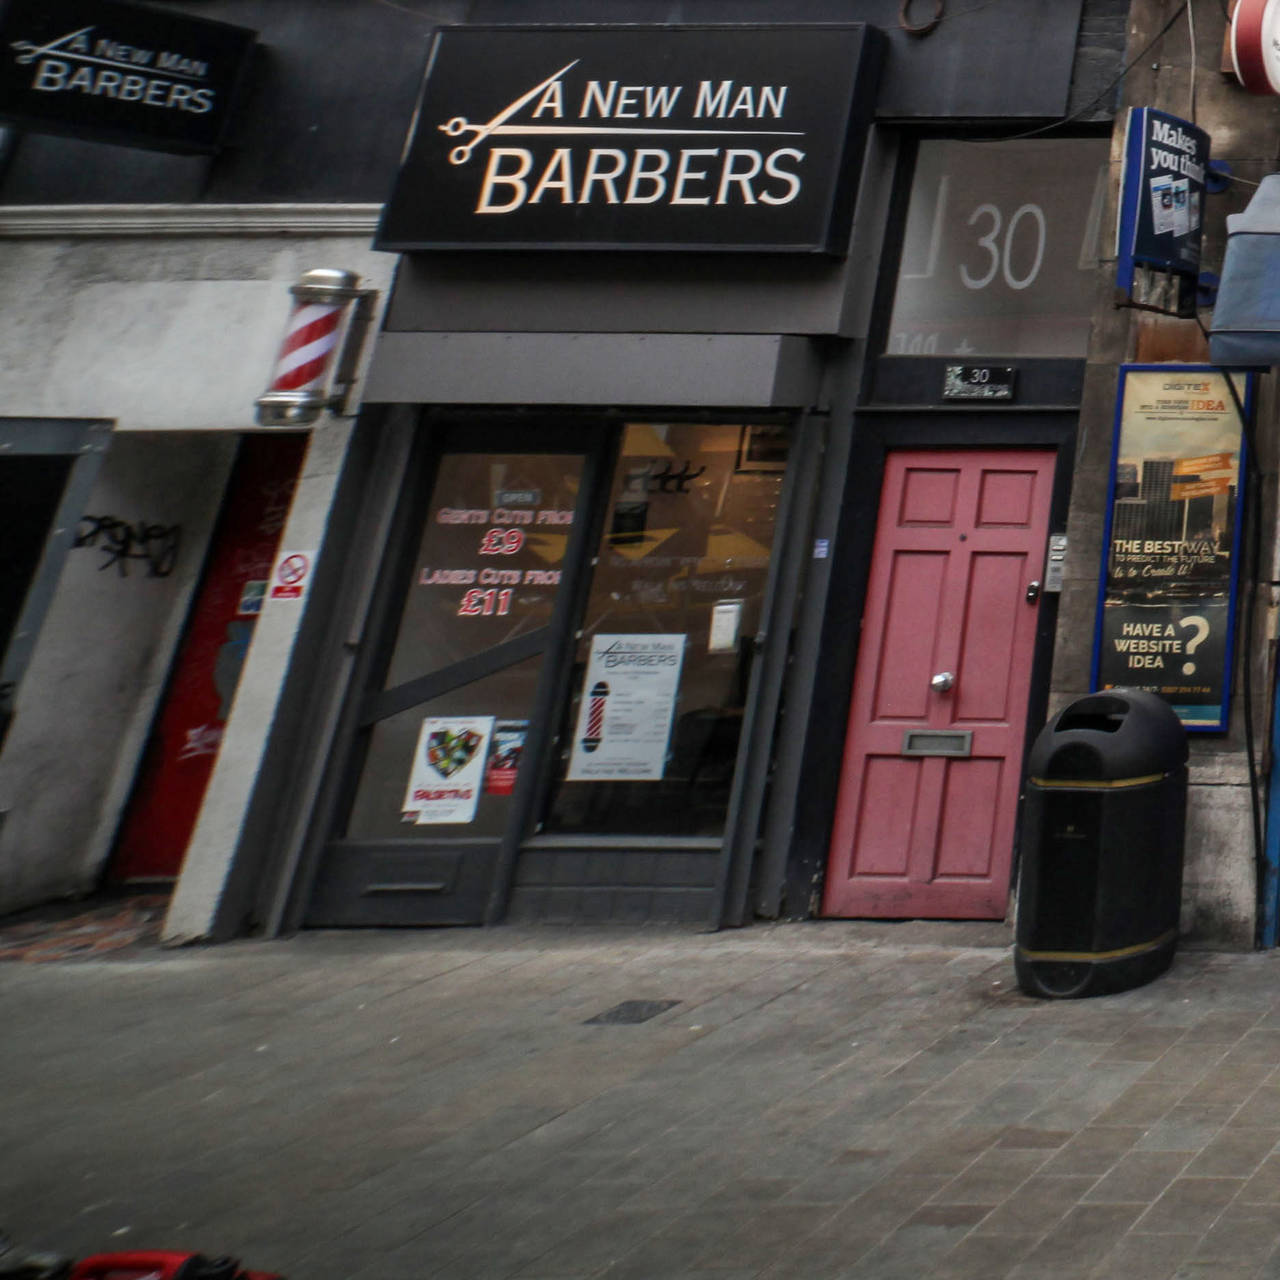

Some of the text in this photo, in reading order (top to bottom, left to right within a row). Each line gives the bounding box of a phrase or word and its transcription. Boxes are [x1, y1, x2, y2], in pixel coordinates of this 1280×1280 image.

[68, 35, 208, 75] A NEW MAN
[32, 60, 216, 113] BARBERS
[532, 81, 787, 118] A NEW MAN
[1152, 120, 1197, 154] Makes
[1151, 147, 1178, 171] you
[474, 148, 805, 214] BARBERS
[960, 203, 1046, 289] 30
[971, 369, 990, 383] 30
[1191, 400, 1225, 411] IDEA
[492, 508, 534, 524] CUTS
[478, 528, 525, 555] £9
[1114, 540, 1220, 554] THE BEST WAY
[1127, 555, 1161, 563] PREDICT
[418, 568, 475, 584] LADIES
[478, 568, 522, 584] CUTS
[457, 588, 513, 616] £11
[1123, 623, 1176, 636] HAVE A
[1114, 640, 1182, 653] WEBSITE
[605, 654, 677, 668] BARBERS
[1128, 656, 1164, 668] IDEA
